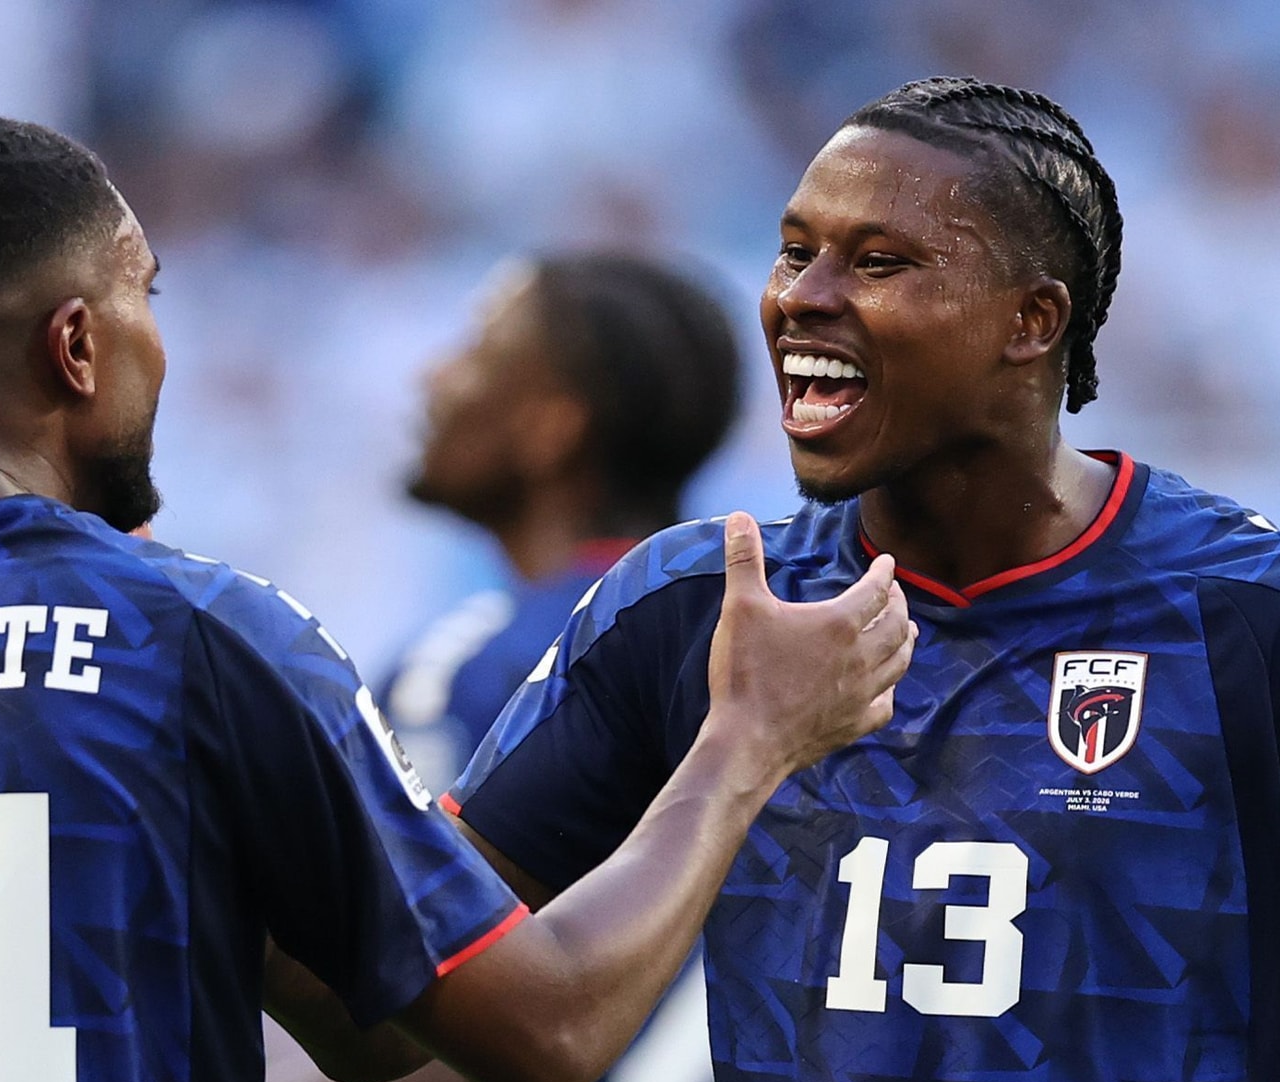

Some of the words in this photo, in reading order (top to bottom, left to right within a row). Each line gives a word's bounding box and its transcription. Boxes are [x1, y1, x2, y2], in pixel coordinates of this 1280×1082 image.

[1064, 659, 1138, 676] FCF
[1039, 788, 1081, 797] ARGENTINA
[1082, 789, 1092, 797] VS
[1092, 789, 1114, 798] CABO
[1114, 790, 1140, 799] VERDE
[1092, 804, 1108, 812] USA
[825, 837, 1029, 1018] 13
